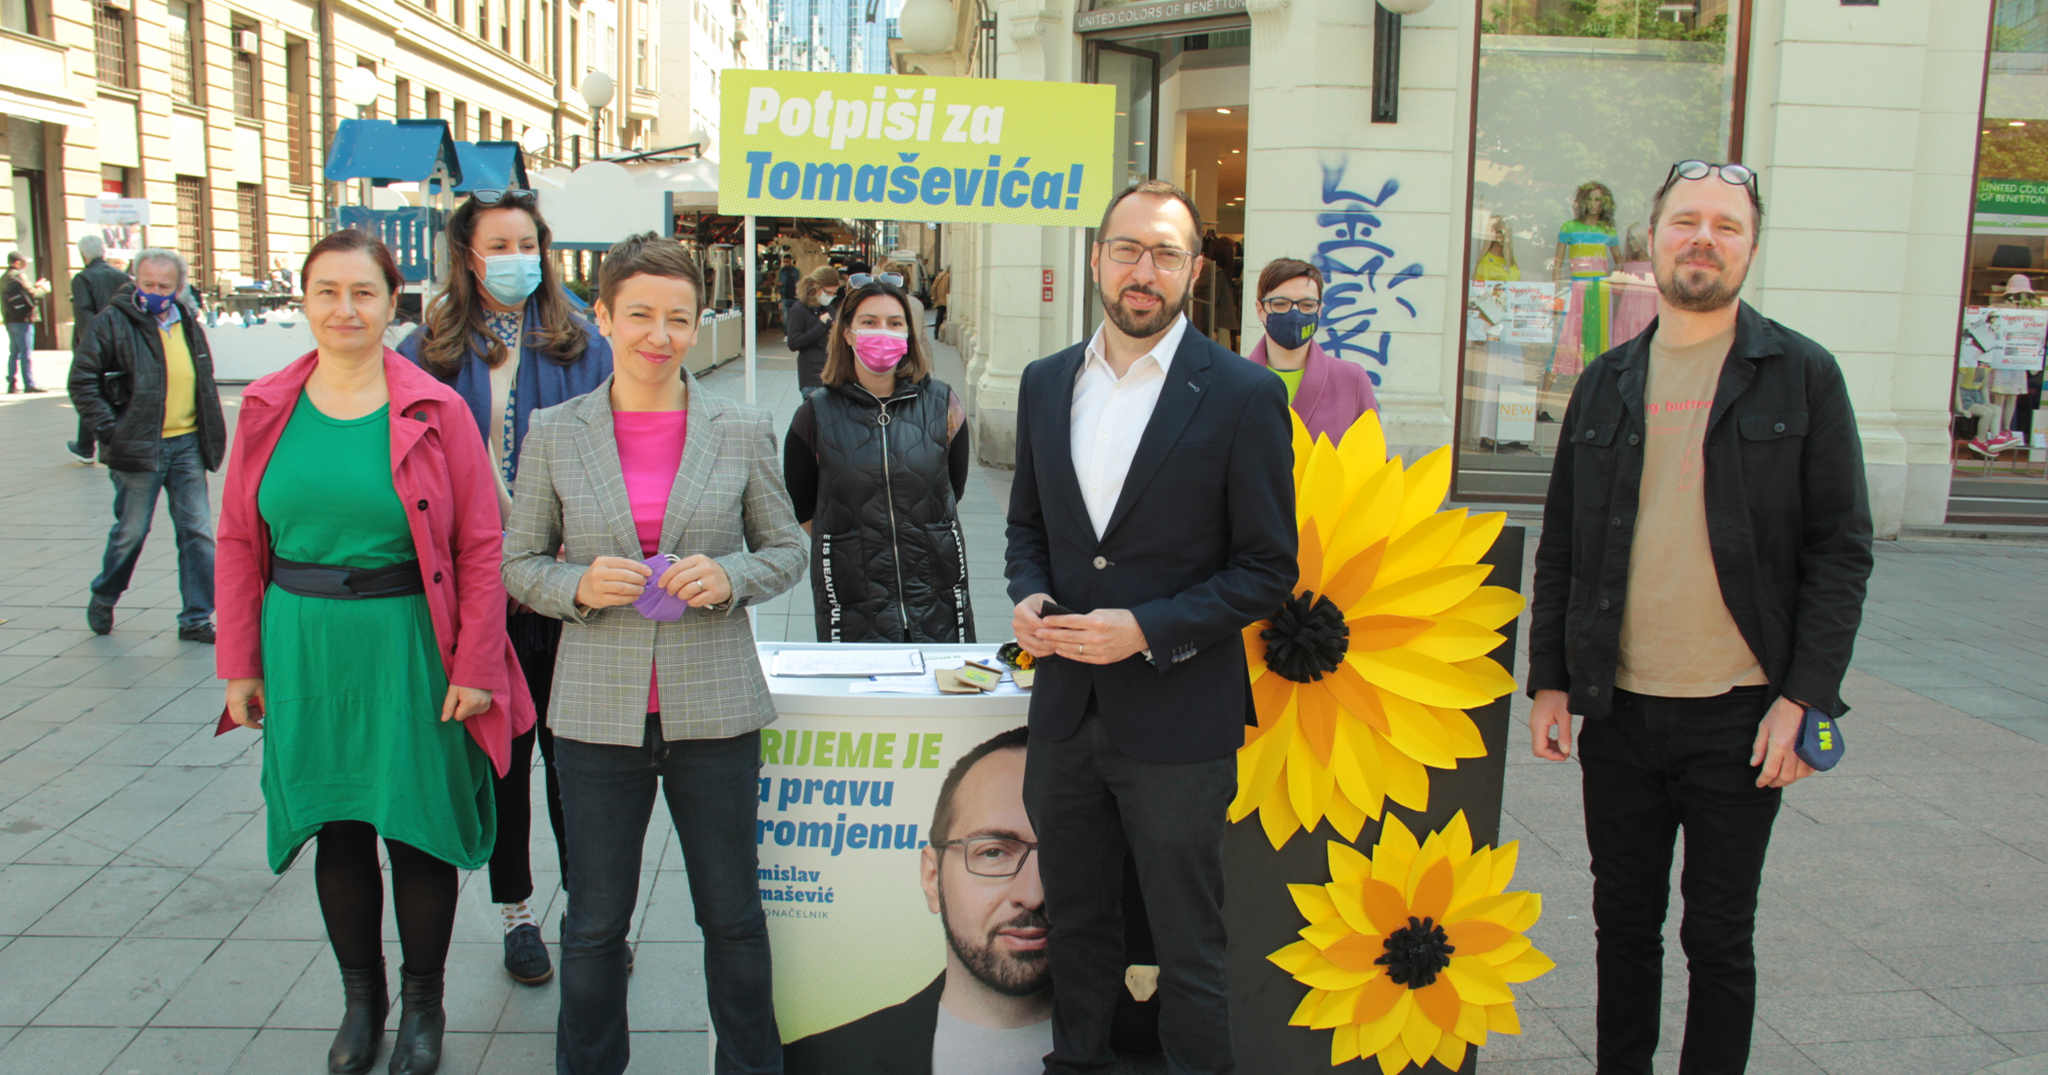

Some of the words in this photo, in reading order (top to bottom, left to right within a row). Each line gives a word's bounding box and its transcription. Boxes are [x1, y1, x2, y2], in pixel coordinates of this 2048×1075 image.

[1078, 13, 1115, 28] UNITED
[1118, 6, 1162, 23] COLORS
[1165, 4, 1180, 17] OF
[1183, 0, 1246, 15] BENETTON
[744, 86, 937, 150] Potpiši
[942, 104, 1005, 144] za
[745, 151, 1084, 210] Tomaševića!
[1981, 182, 2018, 193] UNITED
[2019, 184, 2048, 194] COLO
[1980, 193, 1994, 202] OF
[1301, 322, 1315, 340] M!
[1500, 404, 1534, 416] NEW
[822, 543, 830, 556] IS
[831, 628, 841, 643] LI
[760, 728, 896, 769] RIJEME
[902, 733, 943, 769] JE
[1818, 721, 1833, 750] M!
[758, 777, 772, 802] a
[777, 777, 894, 811] pravu
[757, 813, 928, 857] romjenu.
[757, 864, 821, 882] mislav
[759, 885, 834, 903] mašević
[764, 908, 829, 919] ONAČELNIK
